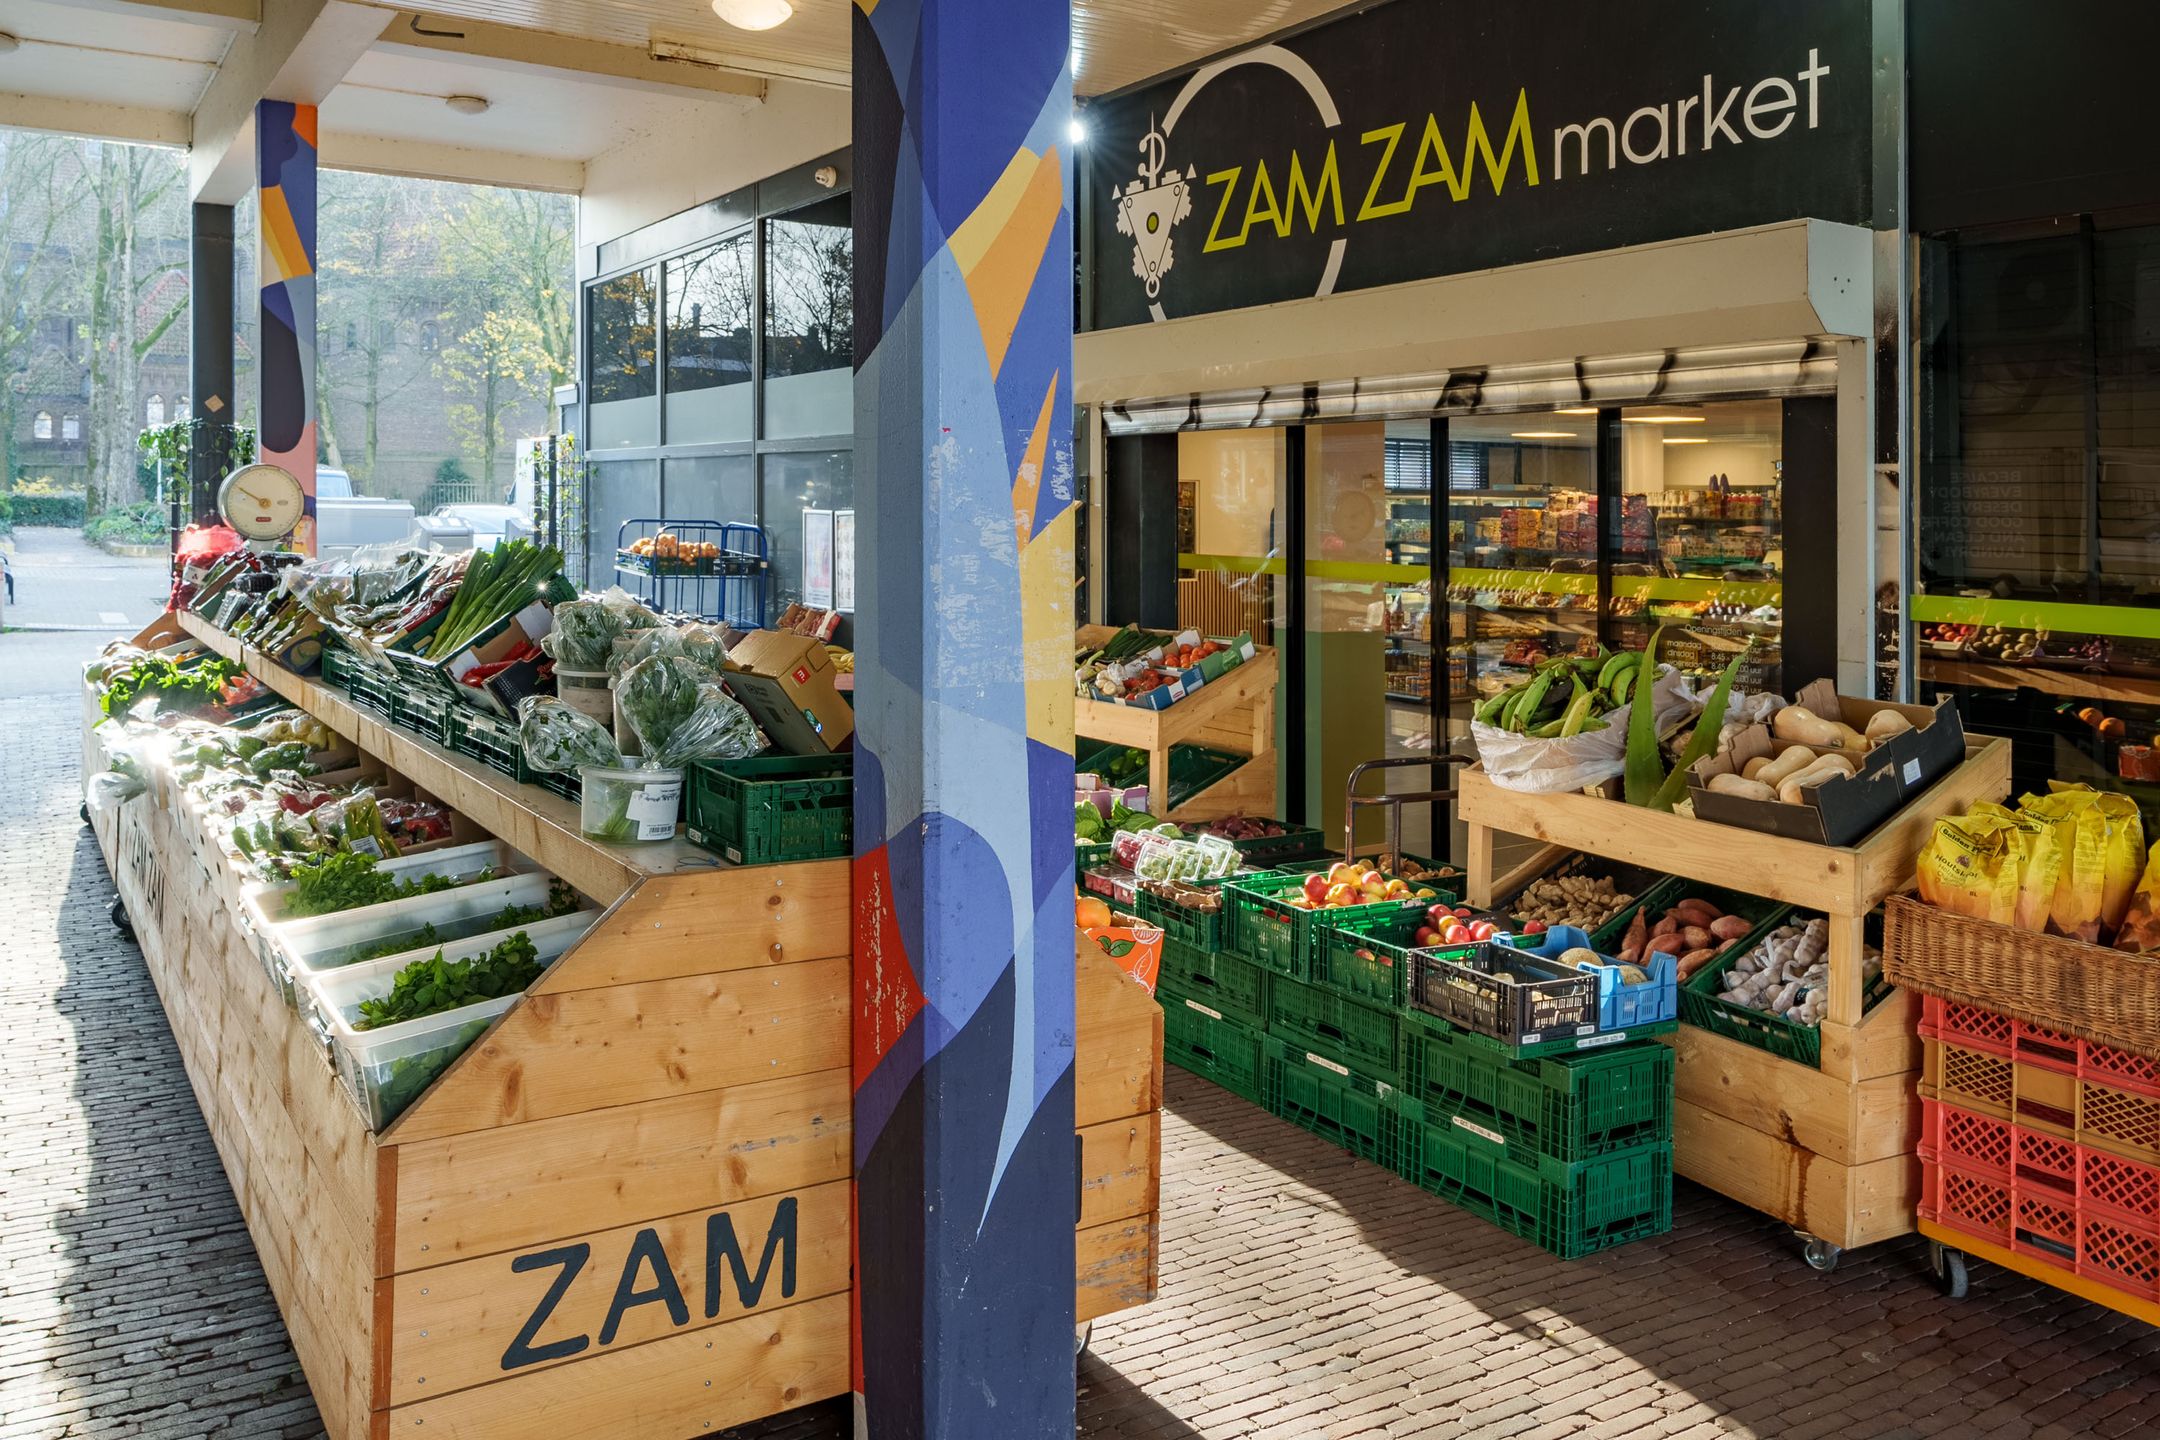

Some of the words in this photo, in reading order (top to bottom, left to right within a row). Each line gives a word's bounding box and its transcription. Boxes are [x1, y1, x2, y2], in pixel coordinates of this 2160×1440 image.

[1203, 139, 1345, 253] ZAM
[1356, 87, 1539, 222] ZAM
[1554, 48, 1830, 180] market
[1685, 624, 1743, 637] Openingstijden
[1666, 640, 1702, 651] maandag
[1666, 649, 1695, 659] dinsdag
[1942, 828, 1970, 851] Golden
[500, 1196, 798, 1371] ZAM
